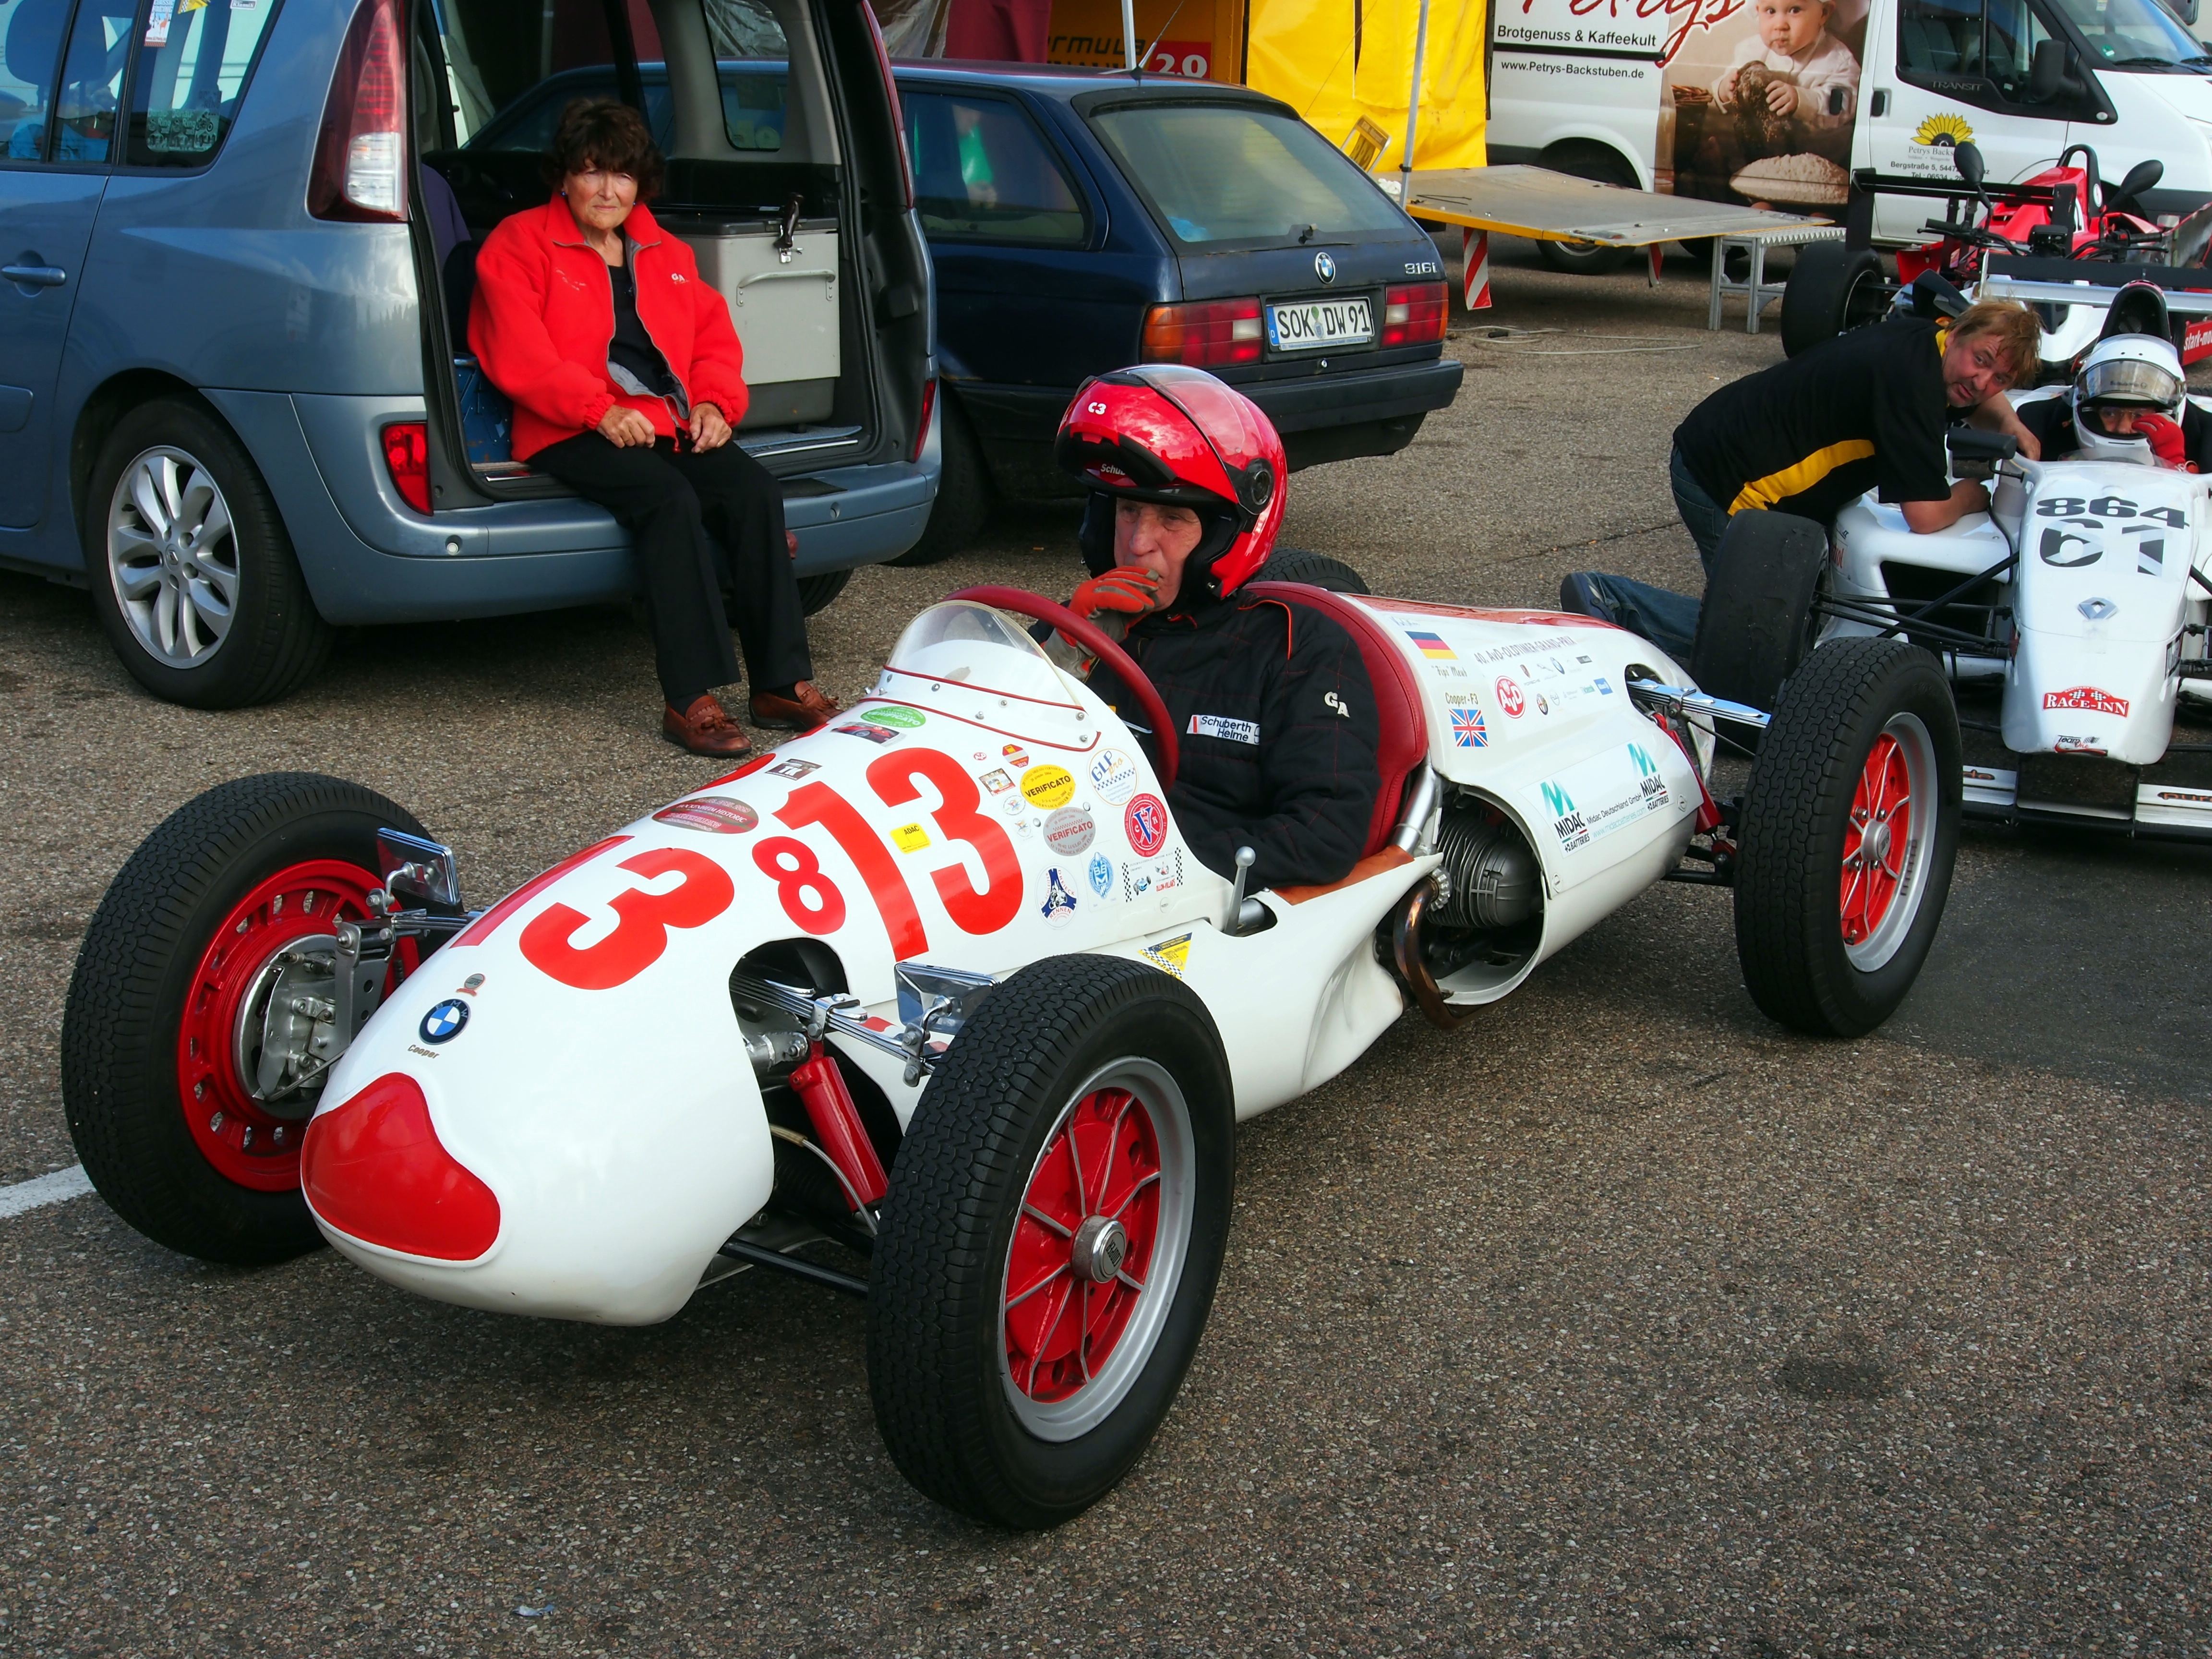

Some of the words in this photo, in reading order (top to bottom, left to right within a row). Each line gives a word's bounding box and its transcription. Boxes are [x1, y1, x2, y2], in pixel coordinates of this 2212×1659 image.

[1497, 25, 1571, 42] Brotgenuss
[1575, 29, 1583, 42] &
[1588, 31, 1657, 47] Kaffeekult
[1501, 60, 1644, 79] www.Petrys-Backstuben.de
[1931, 81, 1983, 91] TRANSIT
[1908, 146, 1930, 156] Petrys
[1932, 147, 1954, 156] Backs
[1890, 161, 1929, 170] Bergstraße
[1405, 262, 1437, 275] 316i
[1277, 308, 1314, 338] SOK
[1322, 306, 1346, 335] DW
[1348, 304, 1370, 334] 91
[1270, 330, 1275, 338] D
[2184, 330, 2212, 351] stark-mo
[1088, 402, 1106, 415] C3
[2036, 496, 2189, 529] 864
[1324, 691, 1350, 718] GA
[1499, 685, 1523, 712] AvD
[2046, 694, 2128, 716] RACE-INN
[1201, 716, 1251, 733] Schuberth
[1217, 728, 1249, 742] Helme
[2058, 735, 2081, 745] Team
[1091, 750, 1112, 782] GLP
[1024, 775, 1071, 798] VERIFICATO
[1640, 774, 1666, 798] MIDAC
[716, 809, 747, 823] HISTORIC
[1586, 814, 1601, 825] Midac
[1601, 801, 1629, 817] Deutschland
[903, 825, 920, 835] ADAC
[1047, 821, 1093, 842] VERIFICATO
[1554, 812, 1586, 839] MIDAC
[1570, 833, 1590, 851] BATTERIES
[772, 747, 1023, 962] 13
[752, 836, 846, 935] 8
[1058, 869, 1075, 895] DREIECK
[1049, 907, 1071, 919] RENNEN
[435, 999, 468, 1018] BMW
[407, 1044, 440, 1059] Cooper
